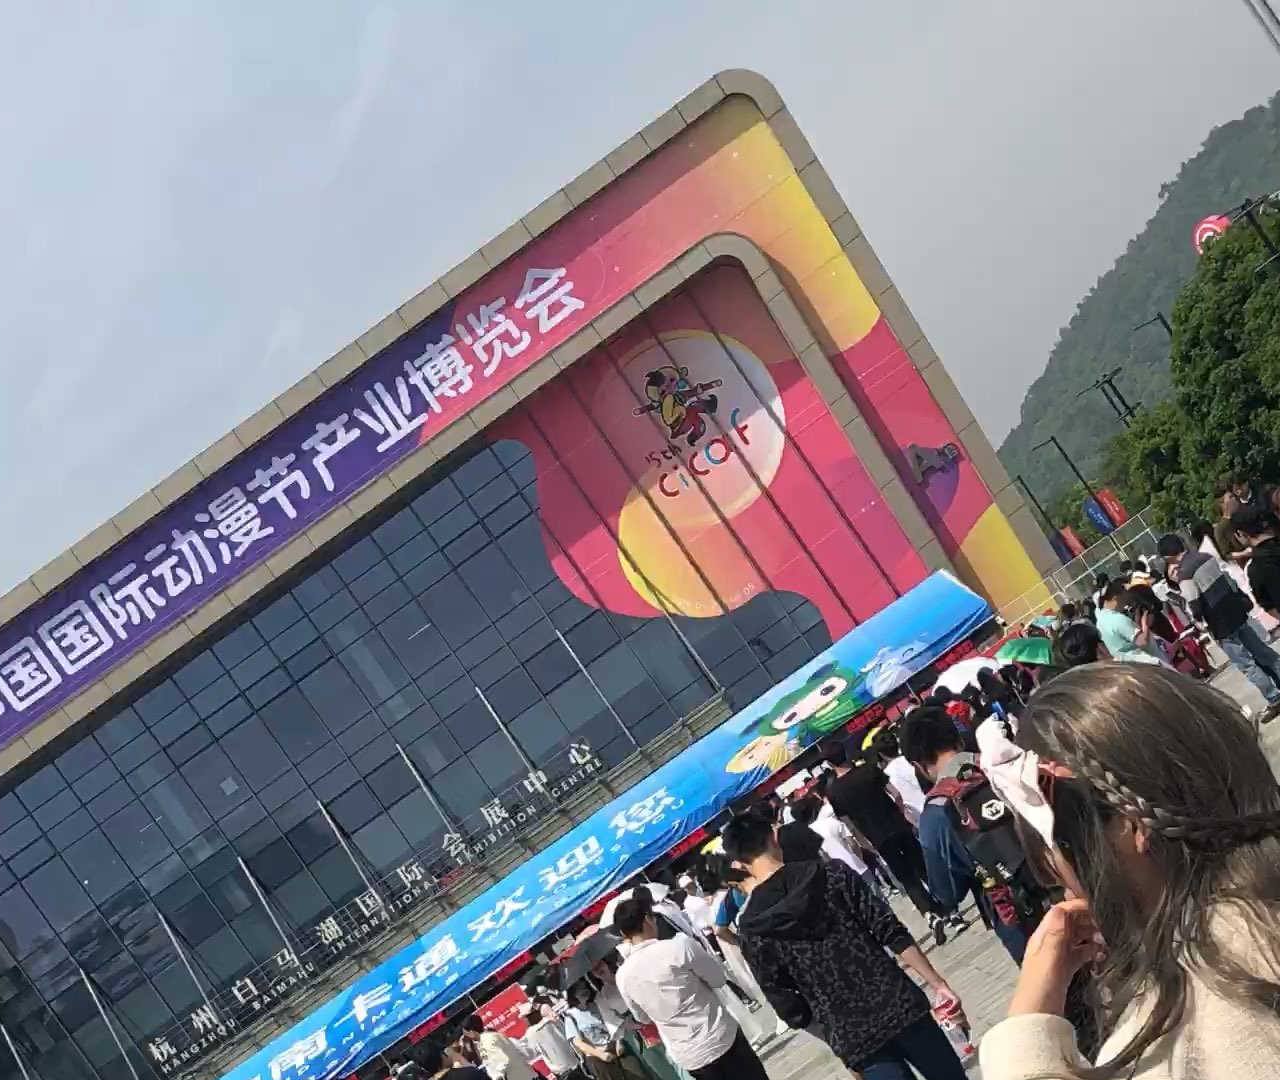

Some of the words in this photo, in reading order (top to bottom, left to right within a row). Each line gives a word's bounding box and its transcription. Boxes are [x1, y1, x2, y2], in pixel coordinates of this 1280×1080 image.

[149, 742, 591, 1063] 杭州白马湖国际会展中心
[160, 1017, 237, 1075] HANGZHOU
[252, 961, 315, 1010] BAIMAHU
[330, 875, 440, 955] INTERNATIONAL
[455, 804, 537, 866] EXHIBITION
[551, 757, 604, 798] CENTRE
